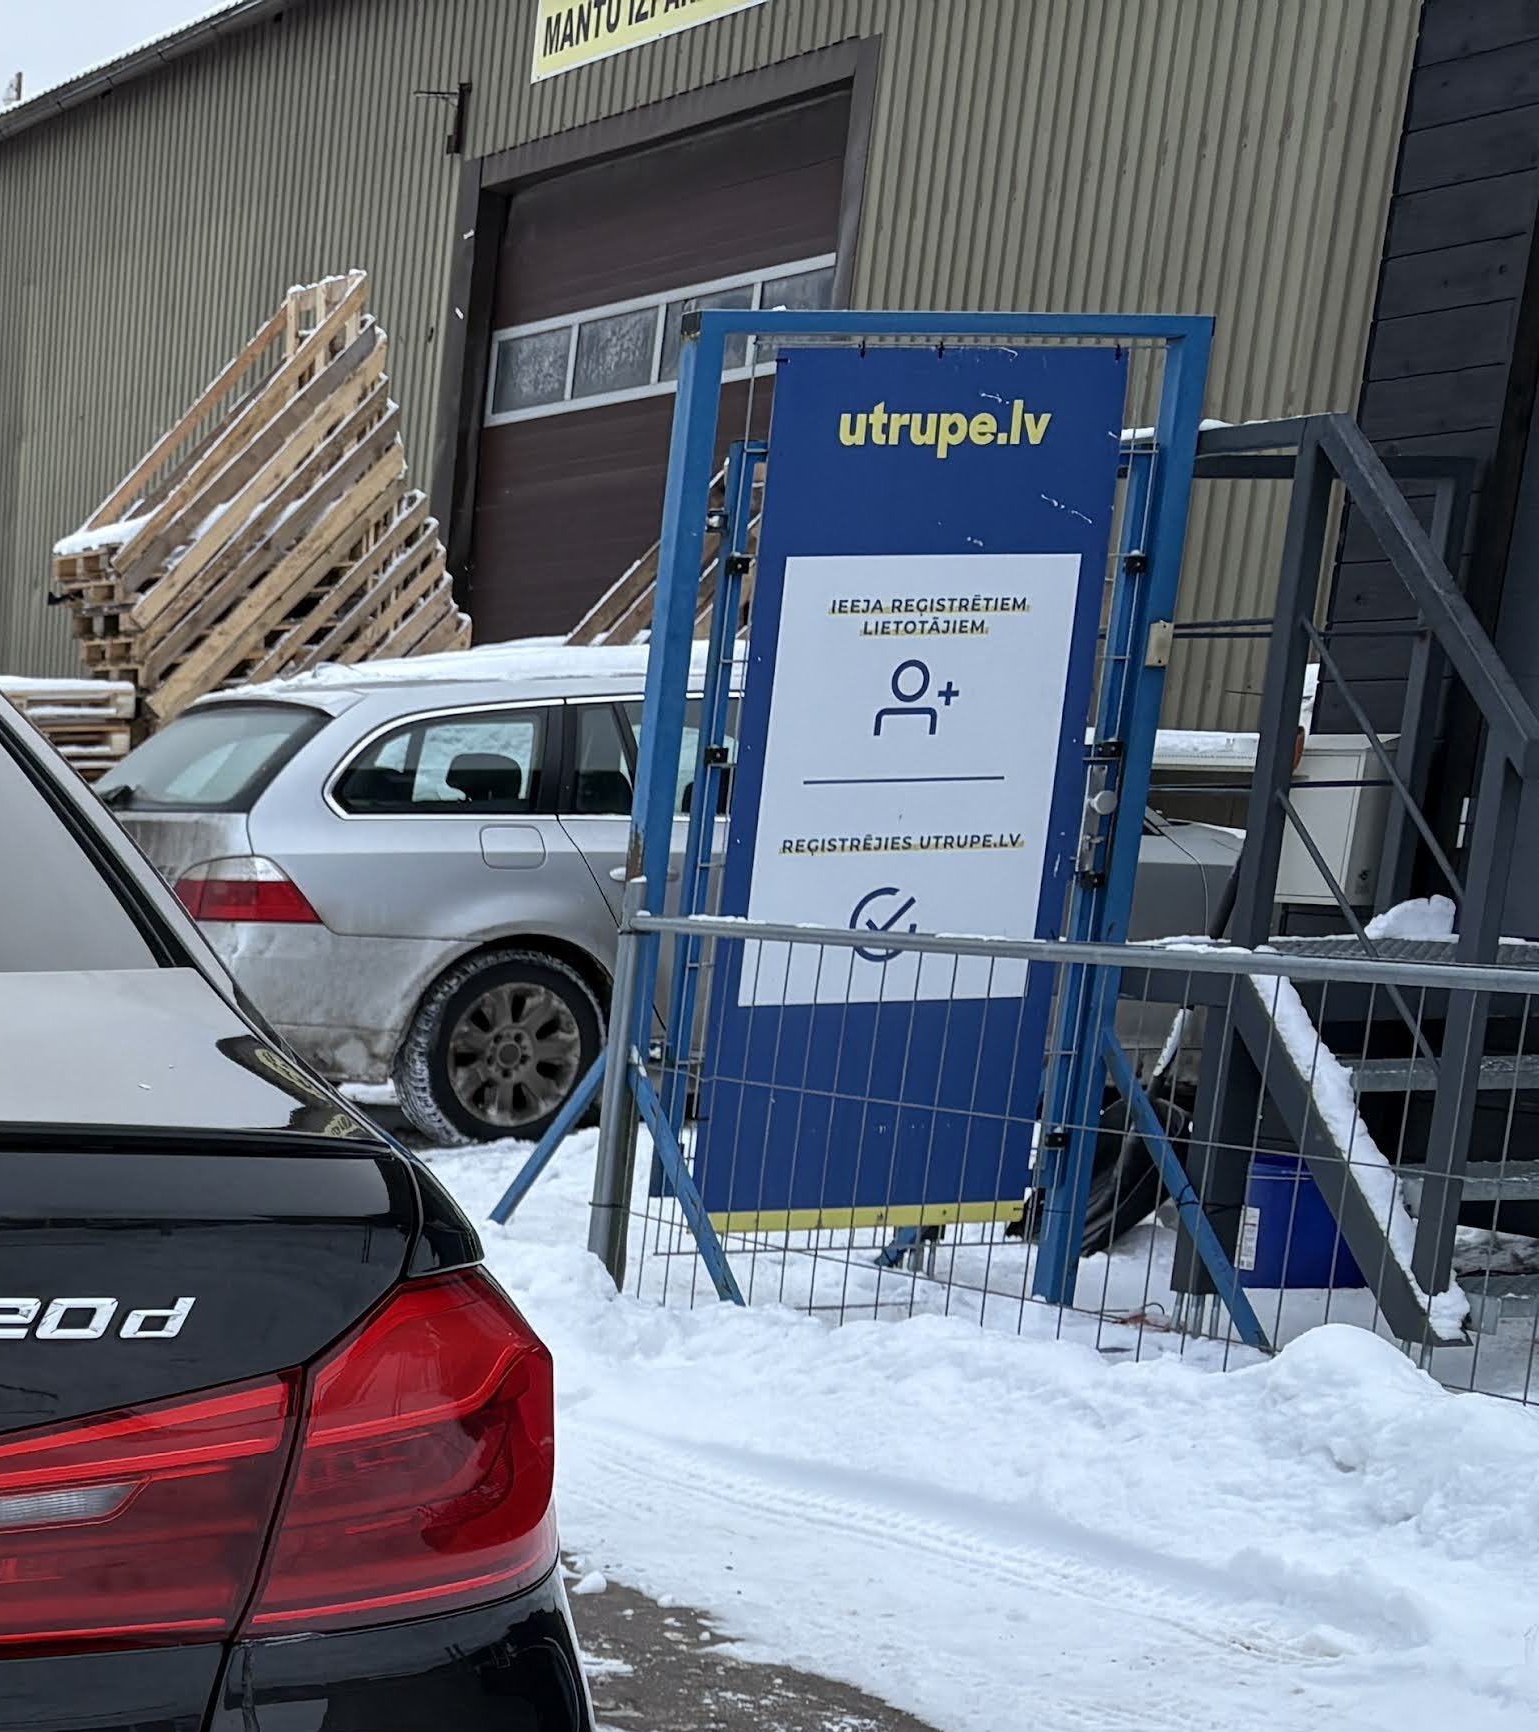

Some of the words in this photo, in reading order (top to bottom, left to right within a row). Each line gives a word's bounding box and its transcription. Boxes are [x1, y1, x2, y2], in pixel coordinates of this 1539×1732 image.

[542, 0, 620, 57] MANTU
[839, 399, 1052, 459] utrupe.lv
[830, 599, 884, 614] IEEJA
[891, 594, 1028, 617] REĢISTRĒTIEM
[862, 616, 986, 636] LIETOTĀJIEM
[781, 834, 913, 856] REĢISTRĒJIES
[919, 833, 1022, 850] UTRUPE.LV
